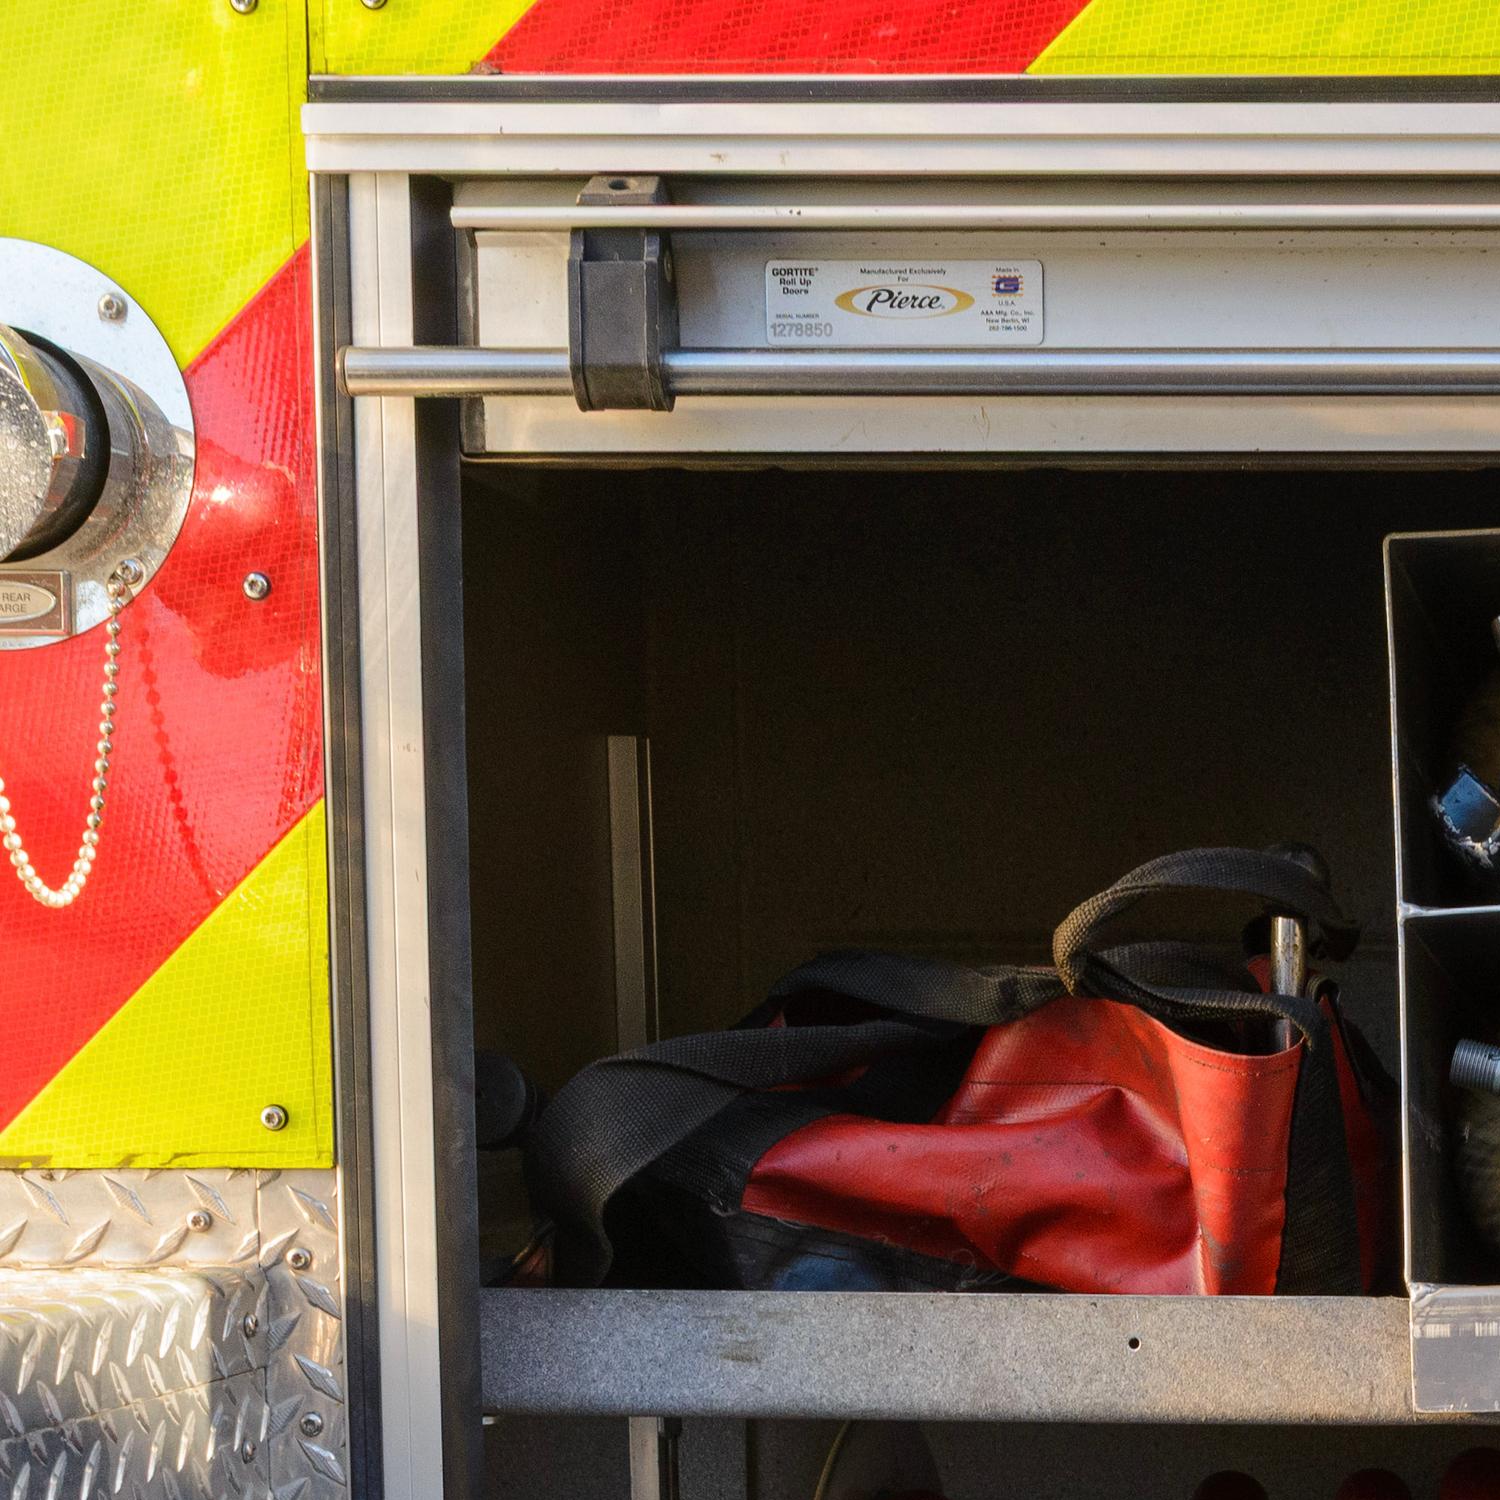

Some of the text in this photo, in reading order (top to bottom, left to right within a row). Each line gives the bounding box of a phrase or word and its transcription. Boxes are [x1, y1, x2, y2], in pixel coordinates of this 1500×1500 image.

[909, 267, 946, 276] Exclusively
[779, 278, 812, 287] Roll Up
[782, 286, 809, 295] Doors
[866, 288, 942, 313] Pierce
[770, 322, 833, 337] 1278850
[2, 592, 31, 601] REAR
